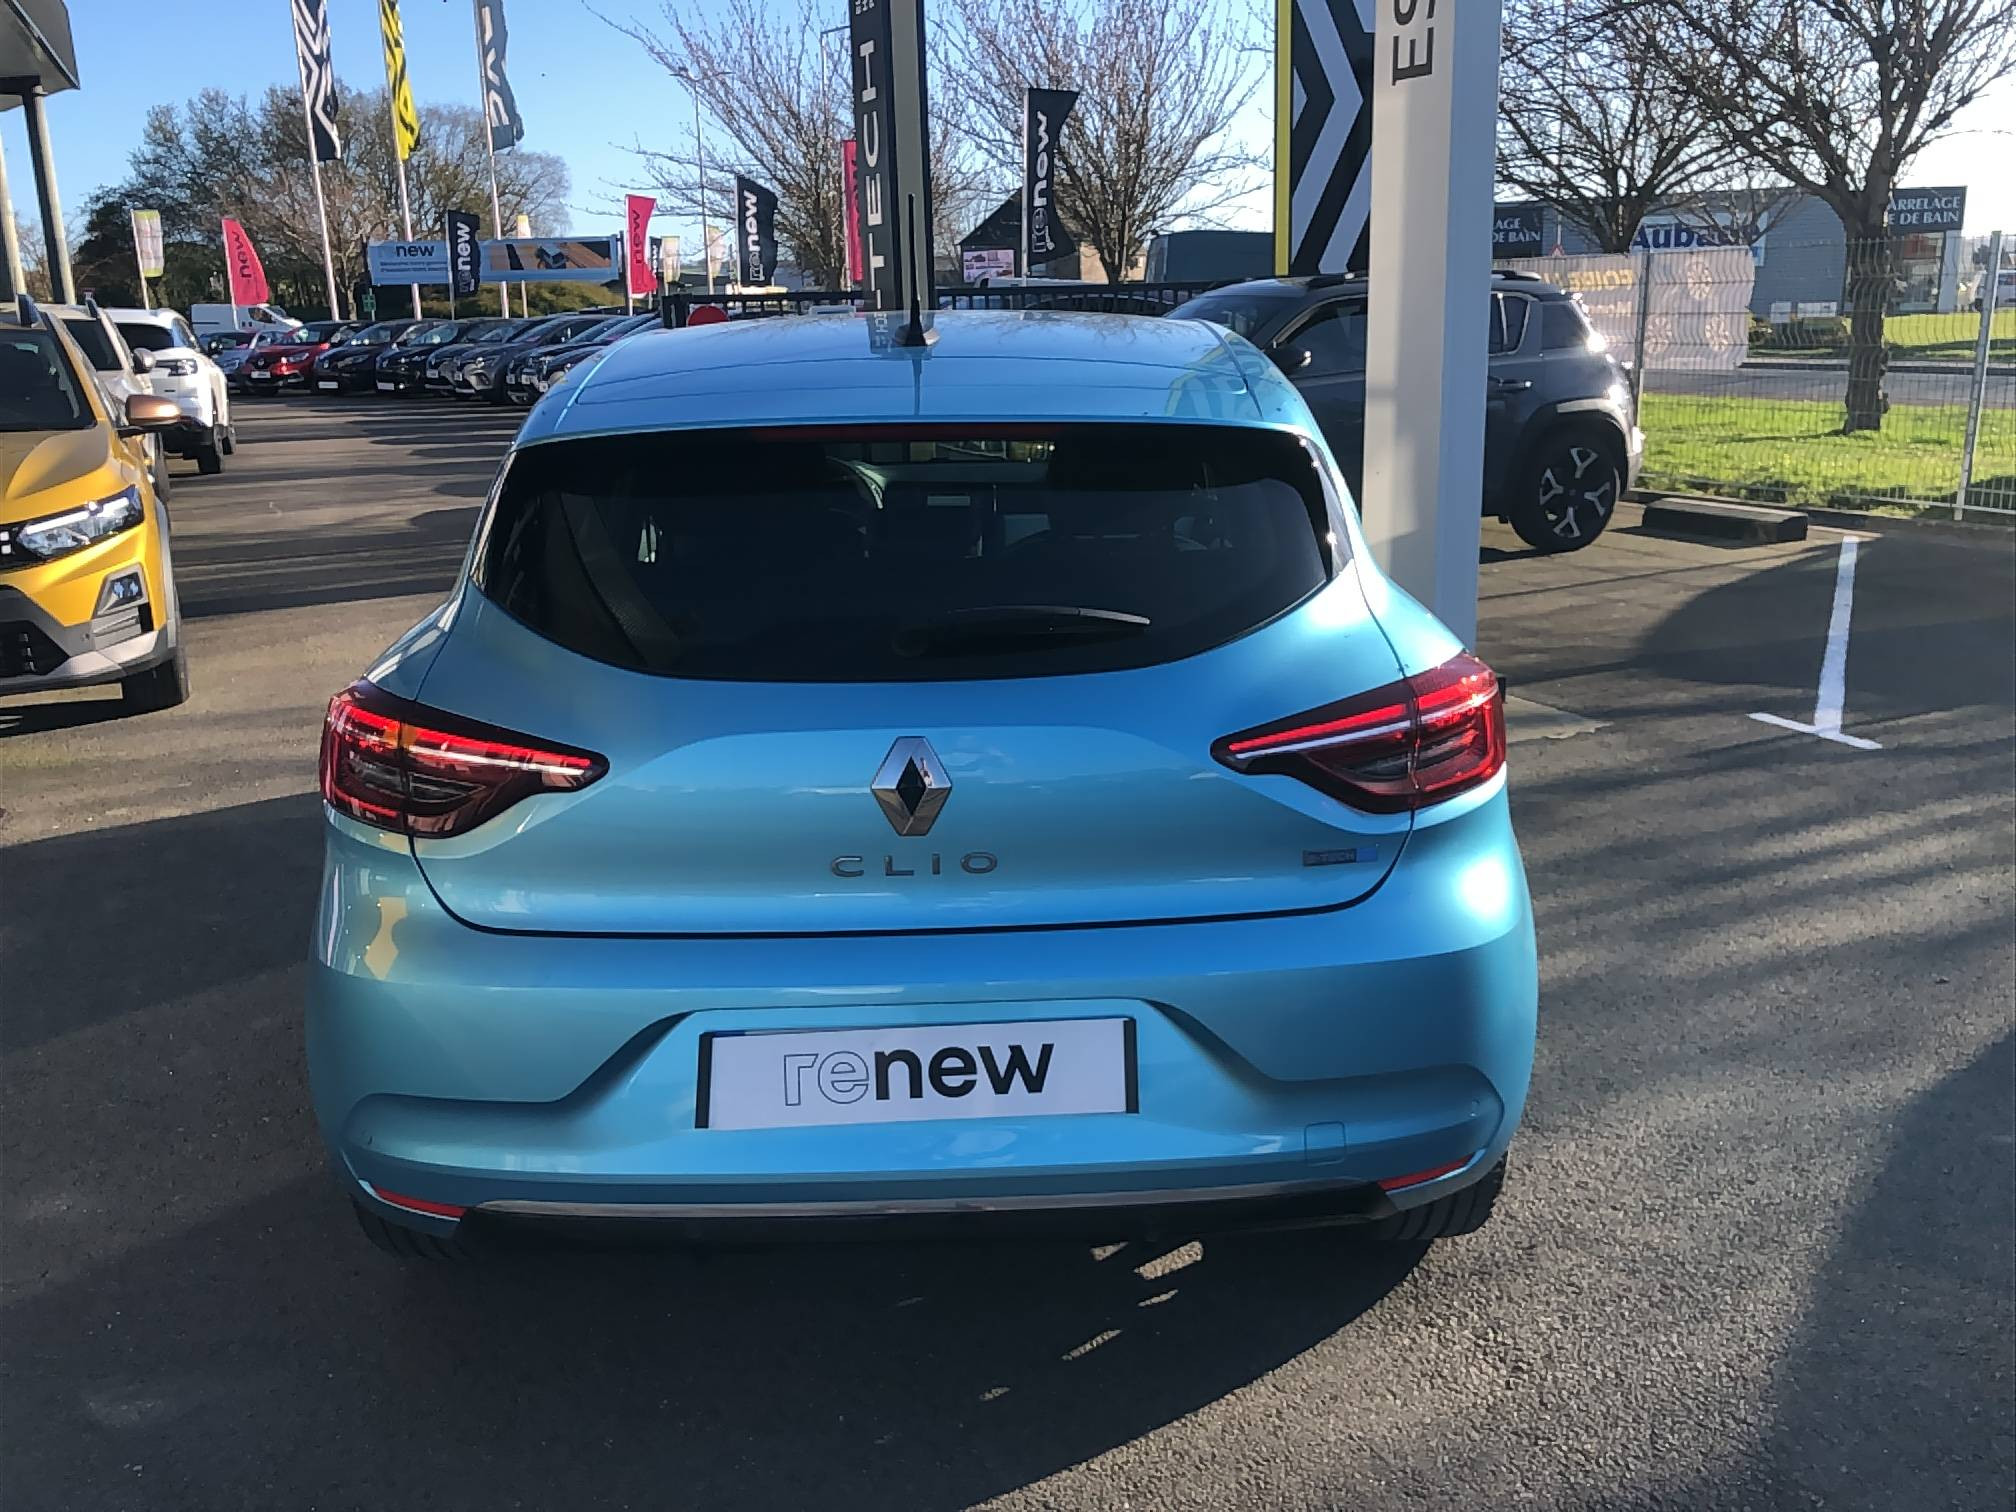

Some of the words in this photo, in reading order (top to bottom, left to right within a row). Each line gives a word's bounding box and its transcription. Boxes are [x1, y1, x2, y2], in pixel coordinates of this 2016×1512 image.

[1900, 212, 1920, 225] DE
[1923, 210, 1960, 224] BAIN
[1508, 231, 1541, 243] BAIN
[830, 851, 998, 878] CLIO
[783, 1042, 1055, 1107] renew
